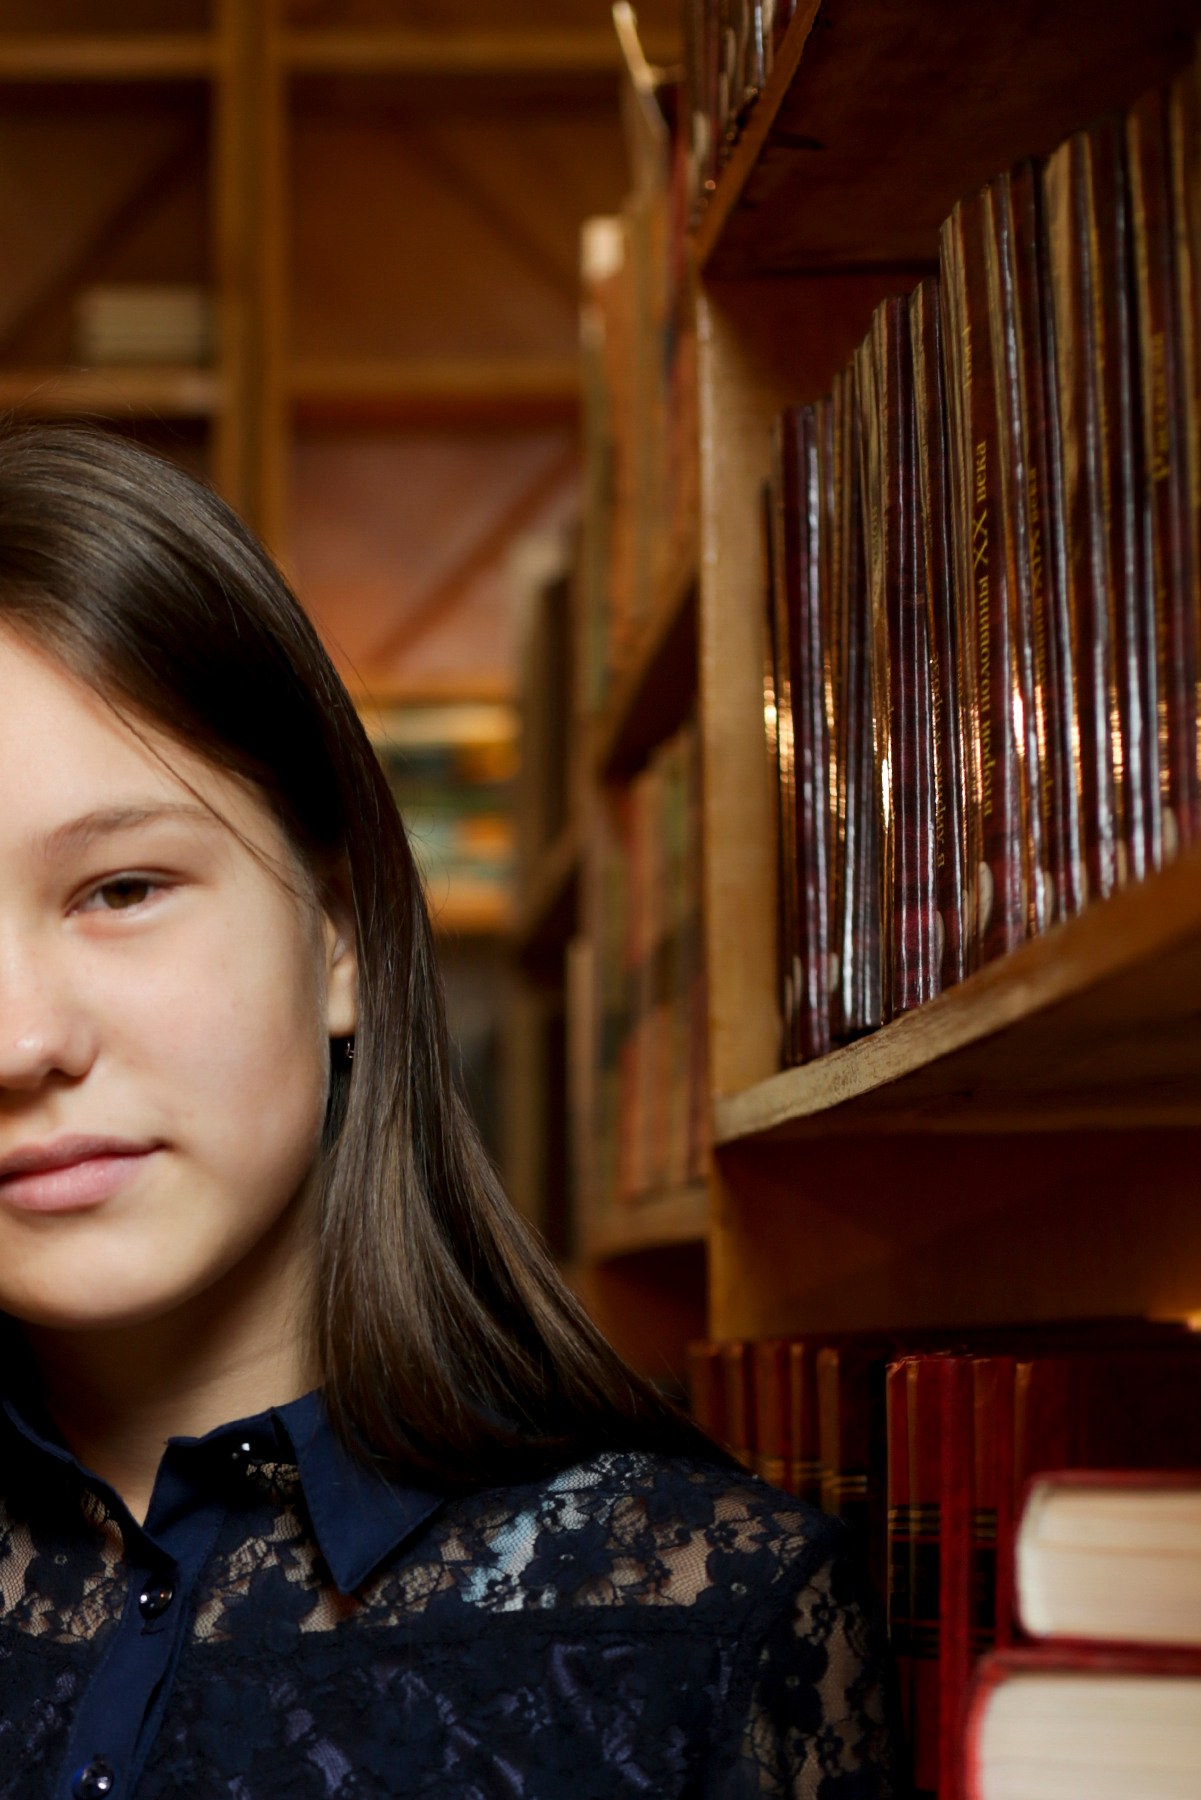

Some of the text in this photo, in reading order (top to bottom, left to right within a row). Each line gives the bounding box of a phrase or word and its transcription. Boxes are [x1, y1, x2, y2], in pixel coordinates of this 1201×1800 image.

[974, 439, 987, 503] века
[972, 509, 989, 569] XX
[976, 575, 991, 713] половины
